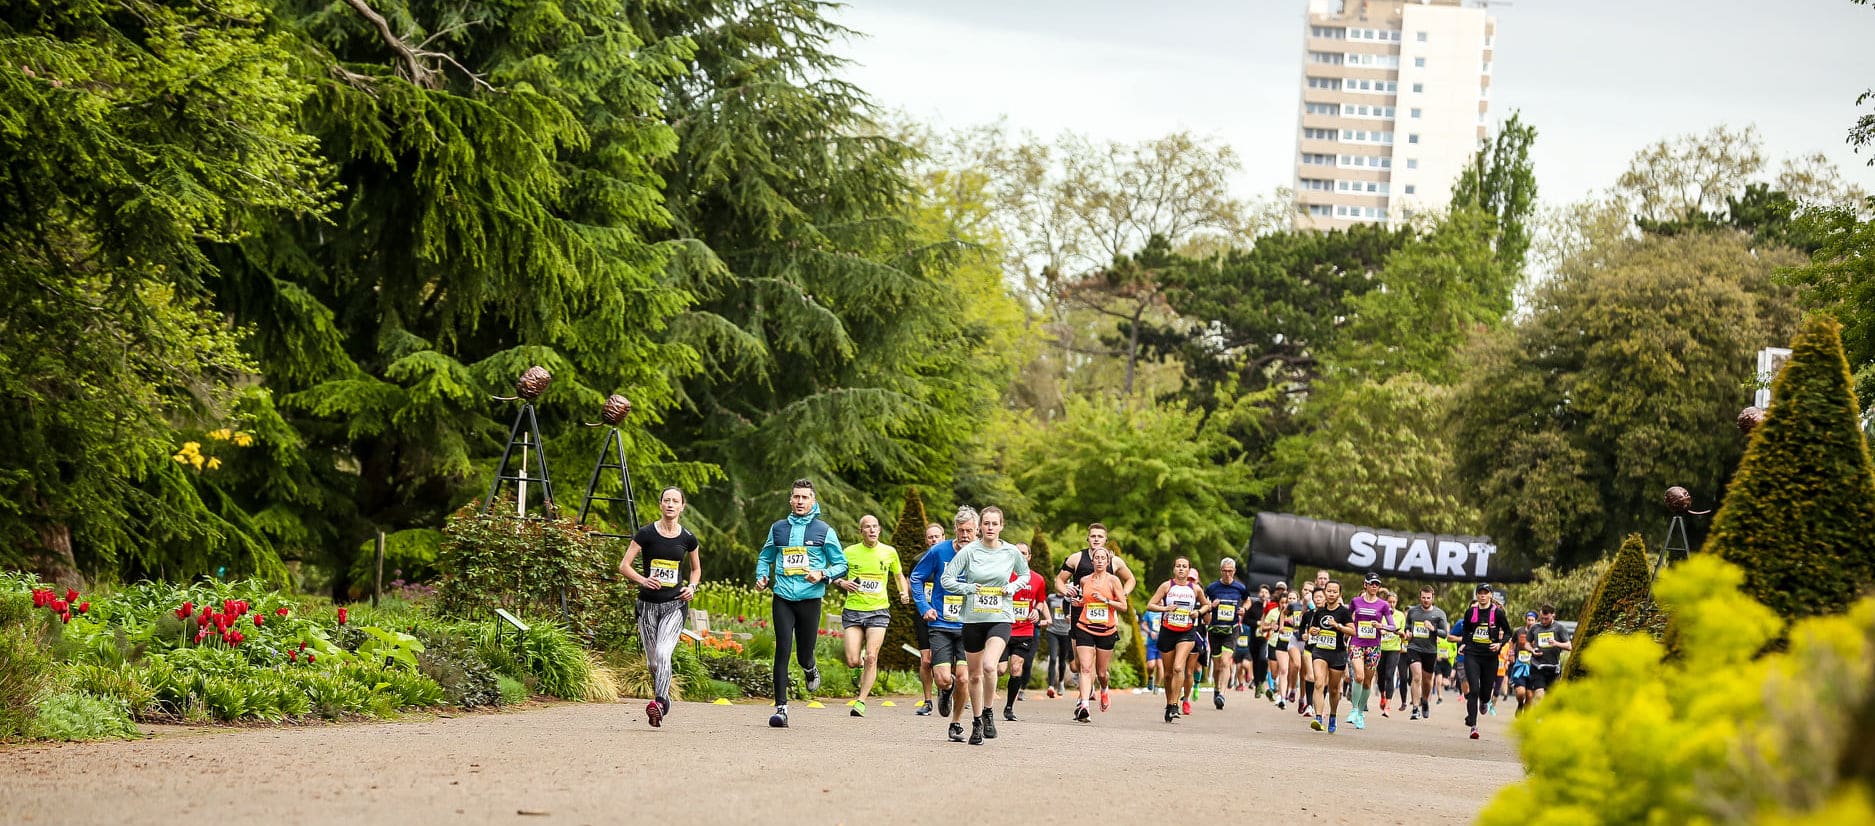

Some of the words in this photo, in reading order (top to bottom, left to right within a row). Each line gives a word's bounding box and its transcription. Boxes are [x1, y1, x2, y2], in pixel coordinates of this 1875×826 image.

[787, 554, 804, 564] 4577
[1348, 531, 1497, 577] START
[861, 580, 879, 590] 4607
[978, 595, 999, 606] 4528
